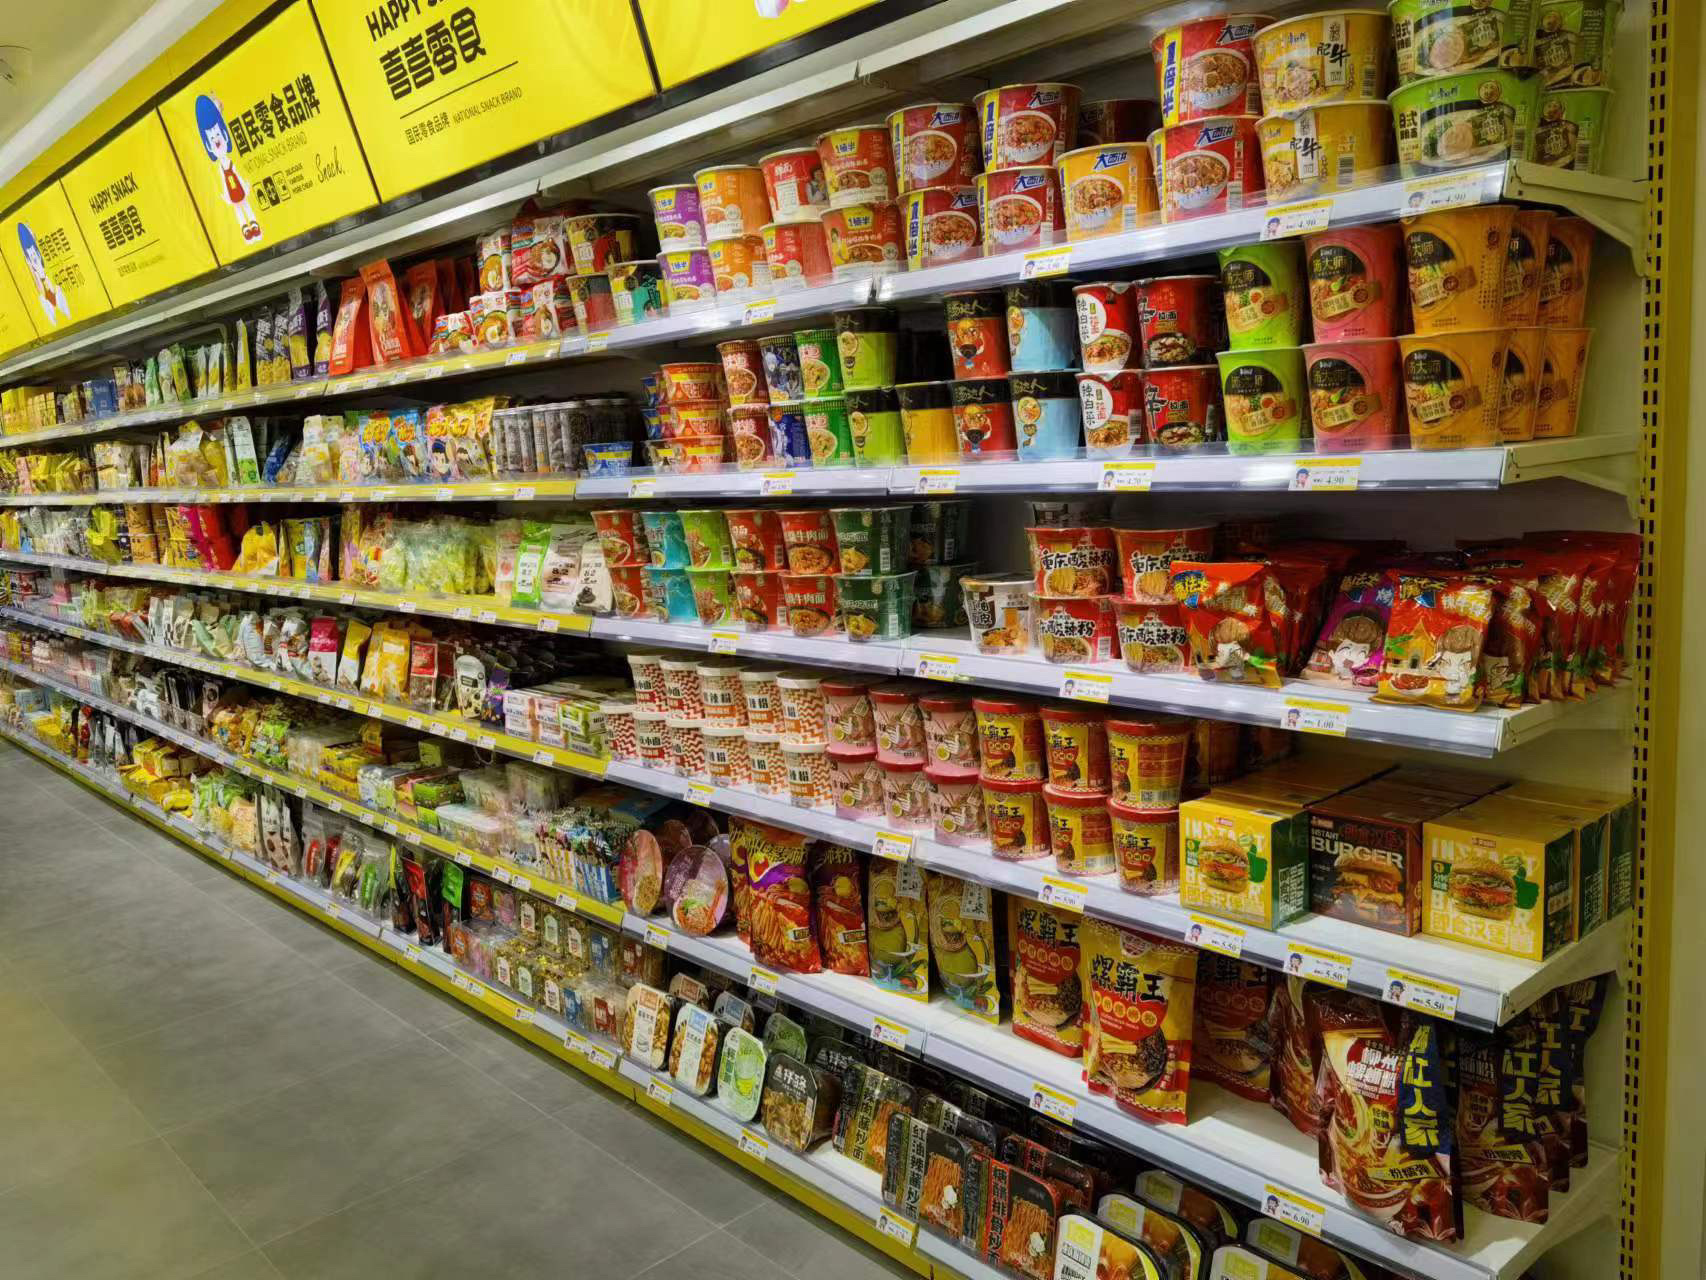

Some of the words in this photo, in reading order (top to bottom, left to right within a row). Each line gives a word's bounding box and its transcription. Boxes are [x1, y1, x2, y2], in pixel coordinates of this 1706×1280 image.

[379, 6, 487, 101] 喜喜零食
[228, 73, 320, 157] 国民零食品牌
[112, 172, 139, 203] SNACK
[1041, 551, 1113, 571] 重庆酸辣粉
[1311, 828, 1339, 840] INSTANT
[1311, 836, 1404, 869] BURGER
[1017, 907, 1080, 950] 螺霸王
[1091, 954, 1165, 1003] 螺霸王
[1424, 999, 1445, 1011] 5.50
[1293, 1213, 1310, 1226] 6.90
